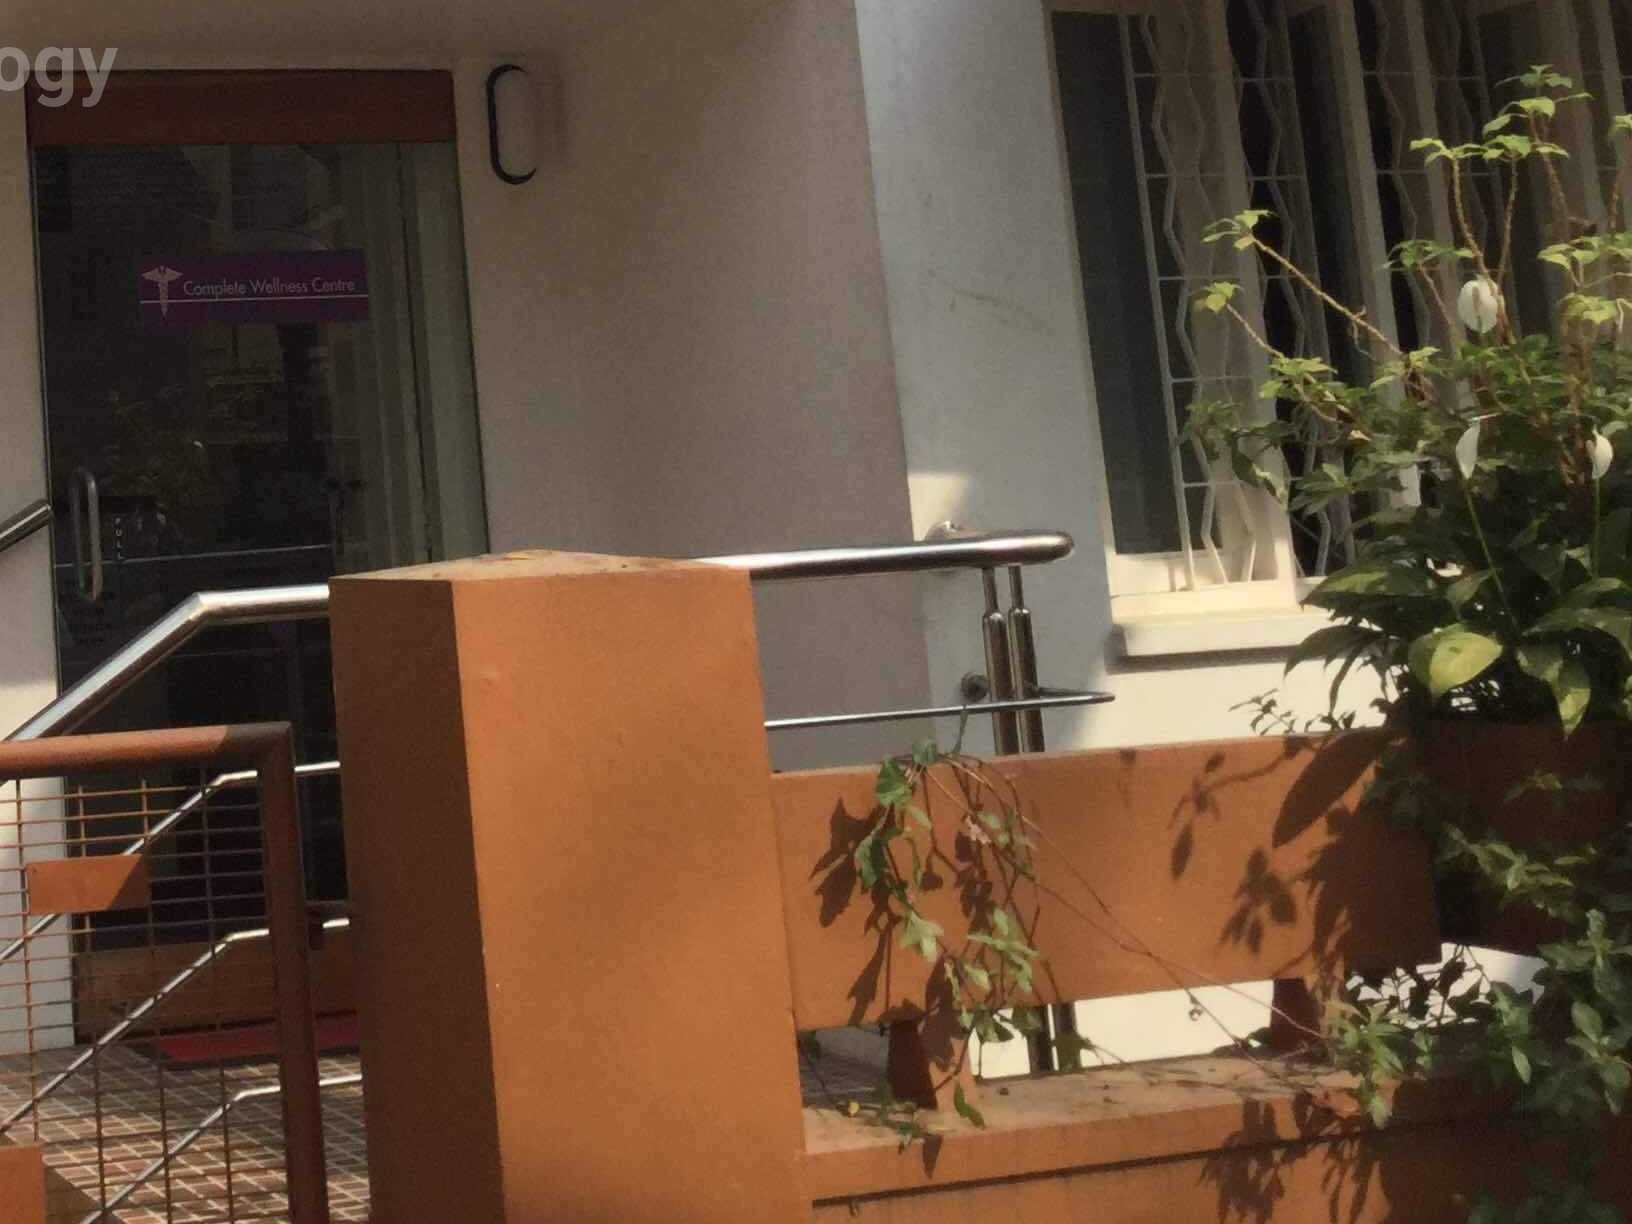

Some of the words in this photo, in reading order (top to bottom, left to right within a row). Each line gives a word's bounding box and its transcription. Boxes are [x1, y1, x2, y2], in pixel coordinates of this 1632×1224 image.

[183, 280, 246, 300] Complete
[250, 278, 308, 294] Wellness
[312, 277, 355, 292] Centre
